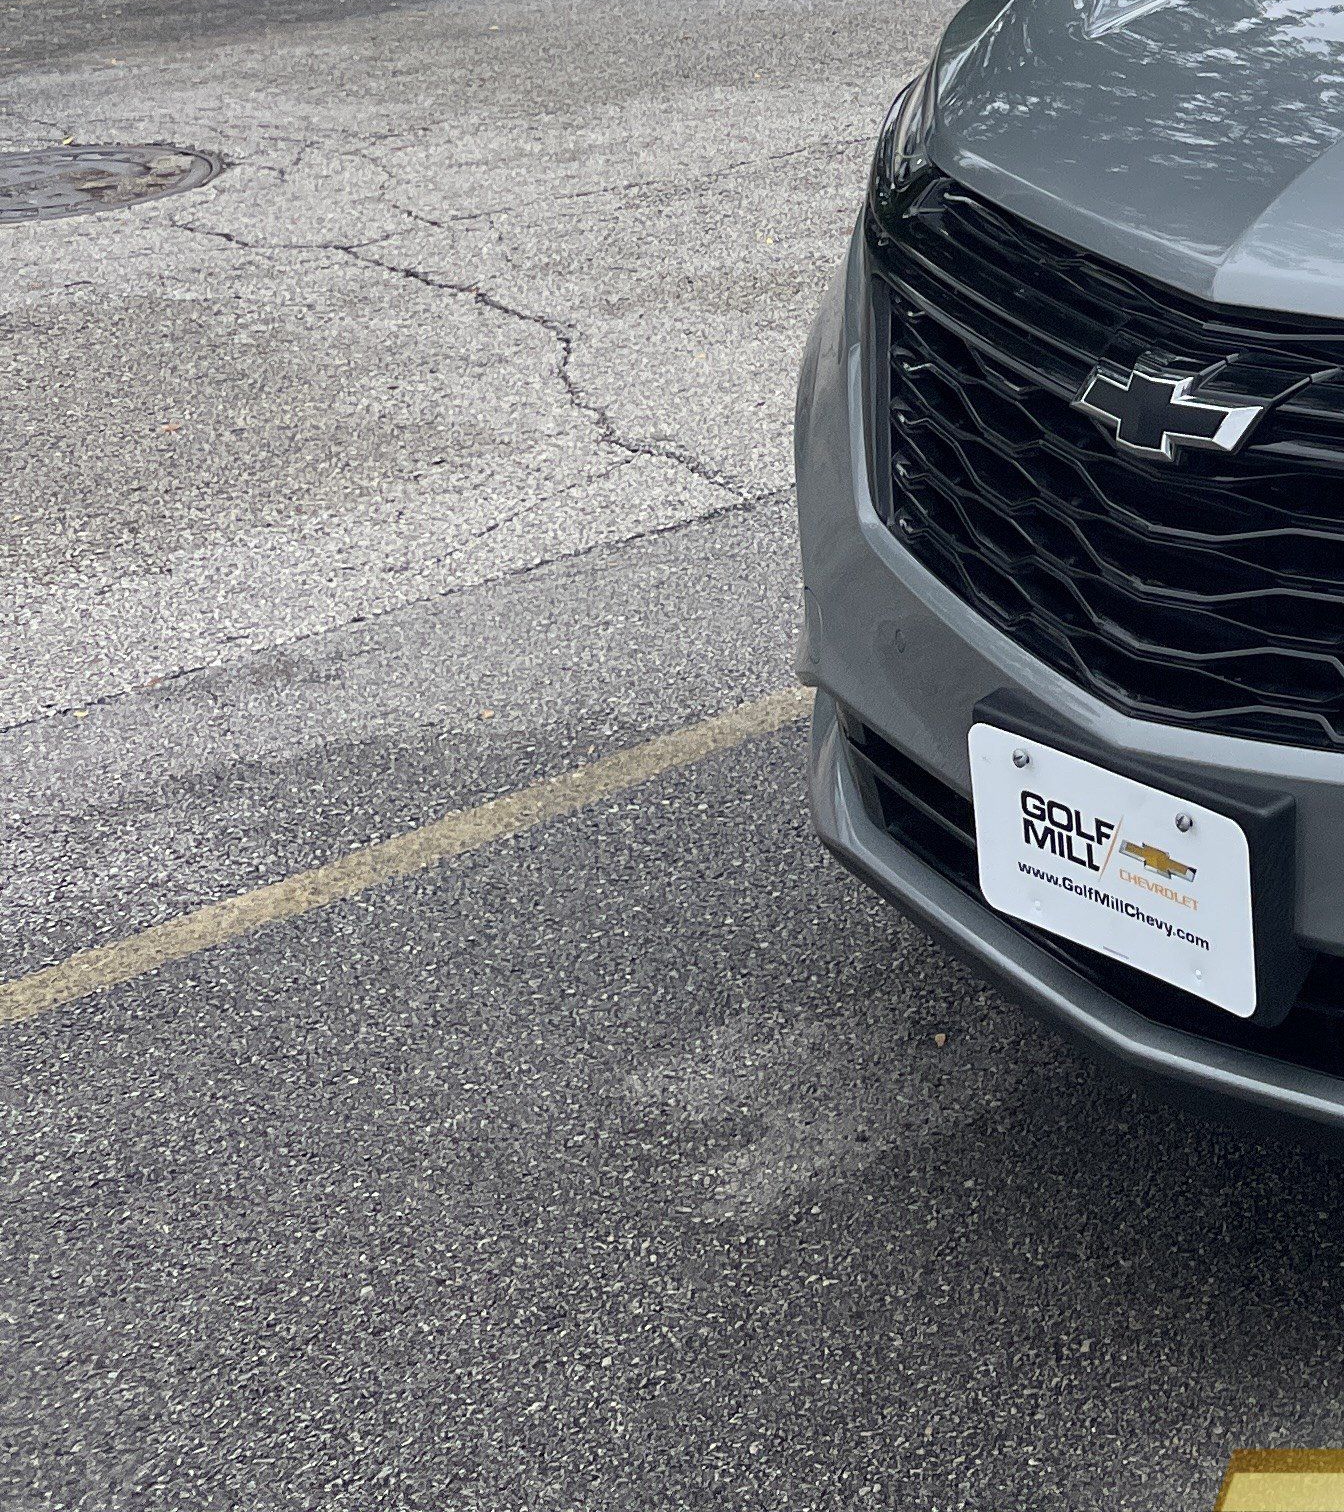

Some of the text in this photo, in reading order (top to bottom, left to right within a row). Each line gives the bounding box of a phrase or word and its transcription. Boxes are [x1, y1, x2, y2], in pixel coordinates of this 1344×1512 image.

[1020, 790, 1115, 846] GOLF
[1022, 817, 1101, 872] MILL
[1017, 861, 1210, 951] www.GolfMillChevy.com
[1119, 868, 1199, 911] CHEVROLET
